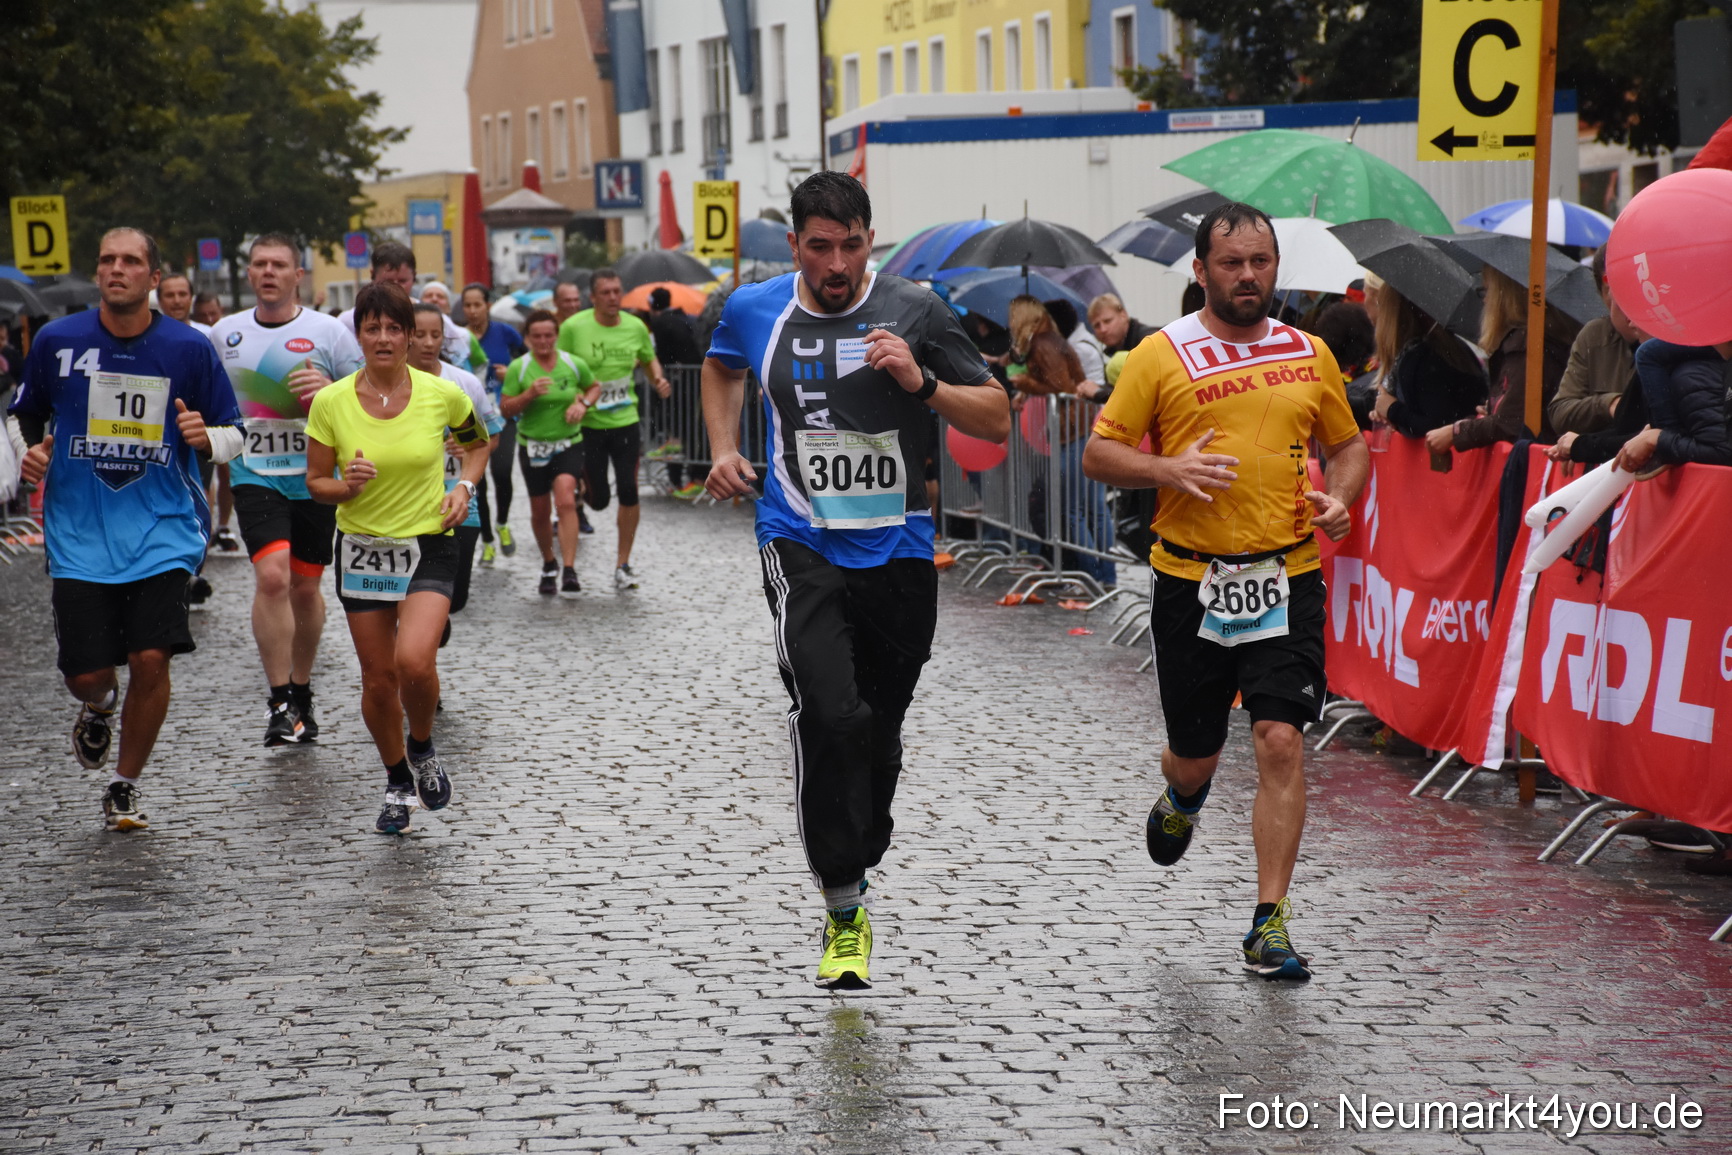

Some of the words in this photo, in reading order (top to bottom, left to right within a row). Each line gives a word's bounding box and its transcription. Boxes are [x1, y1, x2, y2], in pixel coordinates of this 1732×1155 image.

[1453, 18, 1521, 118] C
[698, 184, 733, 198] Block
[17, 200, 59, 215] Block
[706, 204, 728, 240] D
[27, 221, 54, 257] D
[55, 348, 101, 377] 14
[1195, 375, 1259, 406] MAX
[1262, 365, 1322, 387] BÖGL
[115, 391, 146, 419] 10
[111, 423, 143, 437] Simon
[249, 431, 306, 454] 2115
[95, 461, 140, 472] BASKETS
[266, 458, 291, 468] Frank
[809, 454, 897, 491] 3040
[350, 544, 412, 573] 2411
[362, 577, 399, 592] Brigitte
[1208, 577, 1281, 615] 2686
